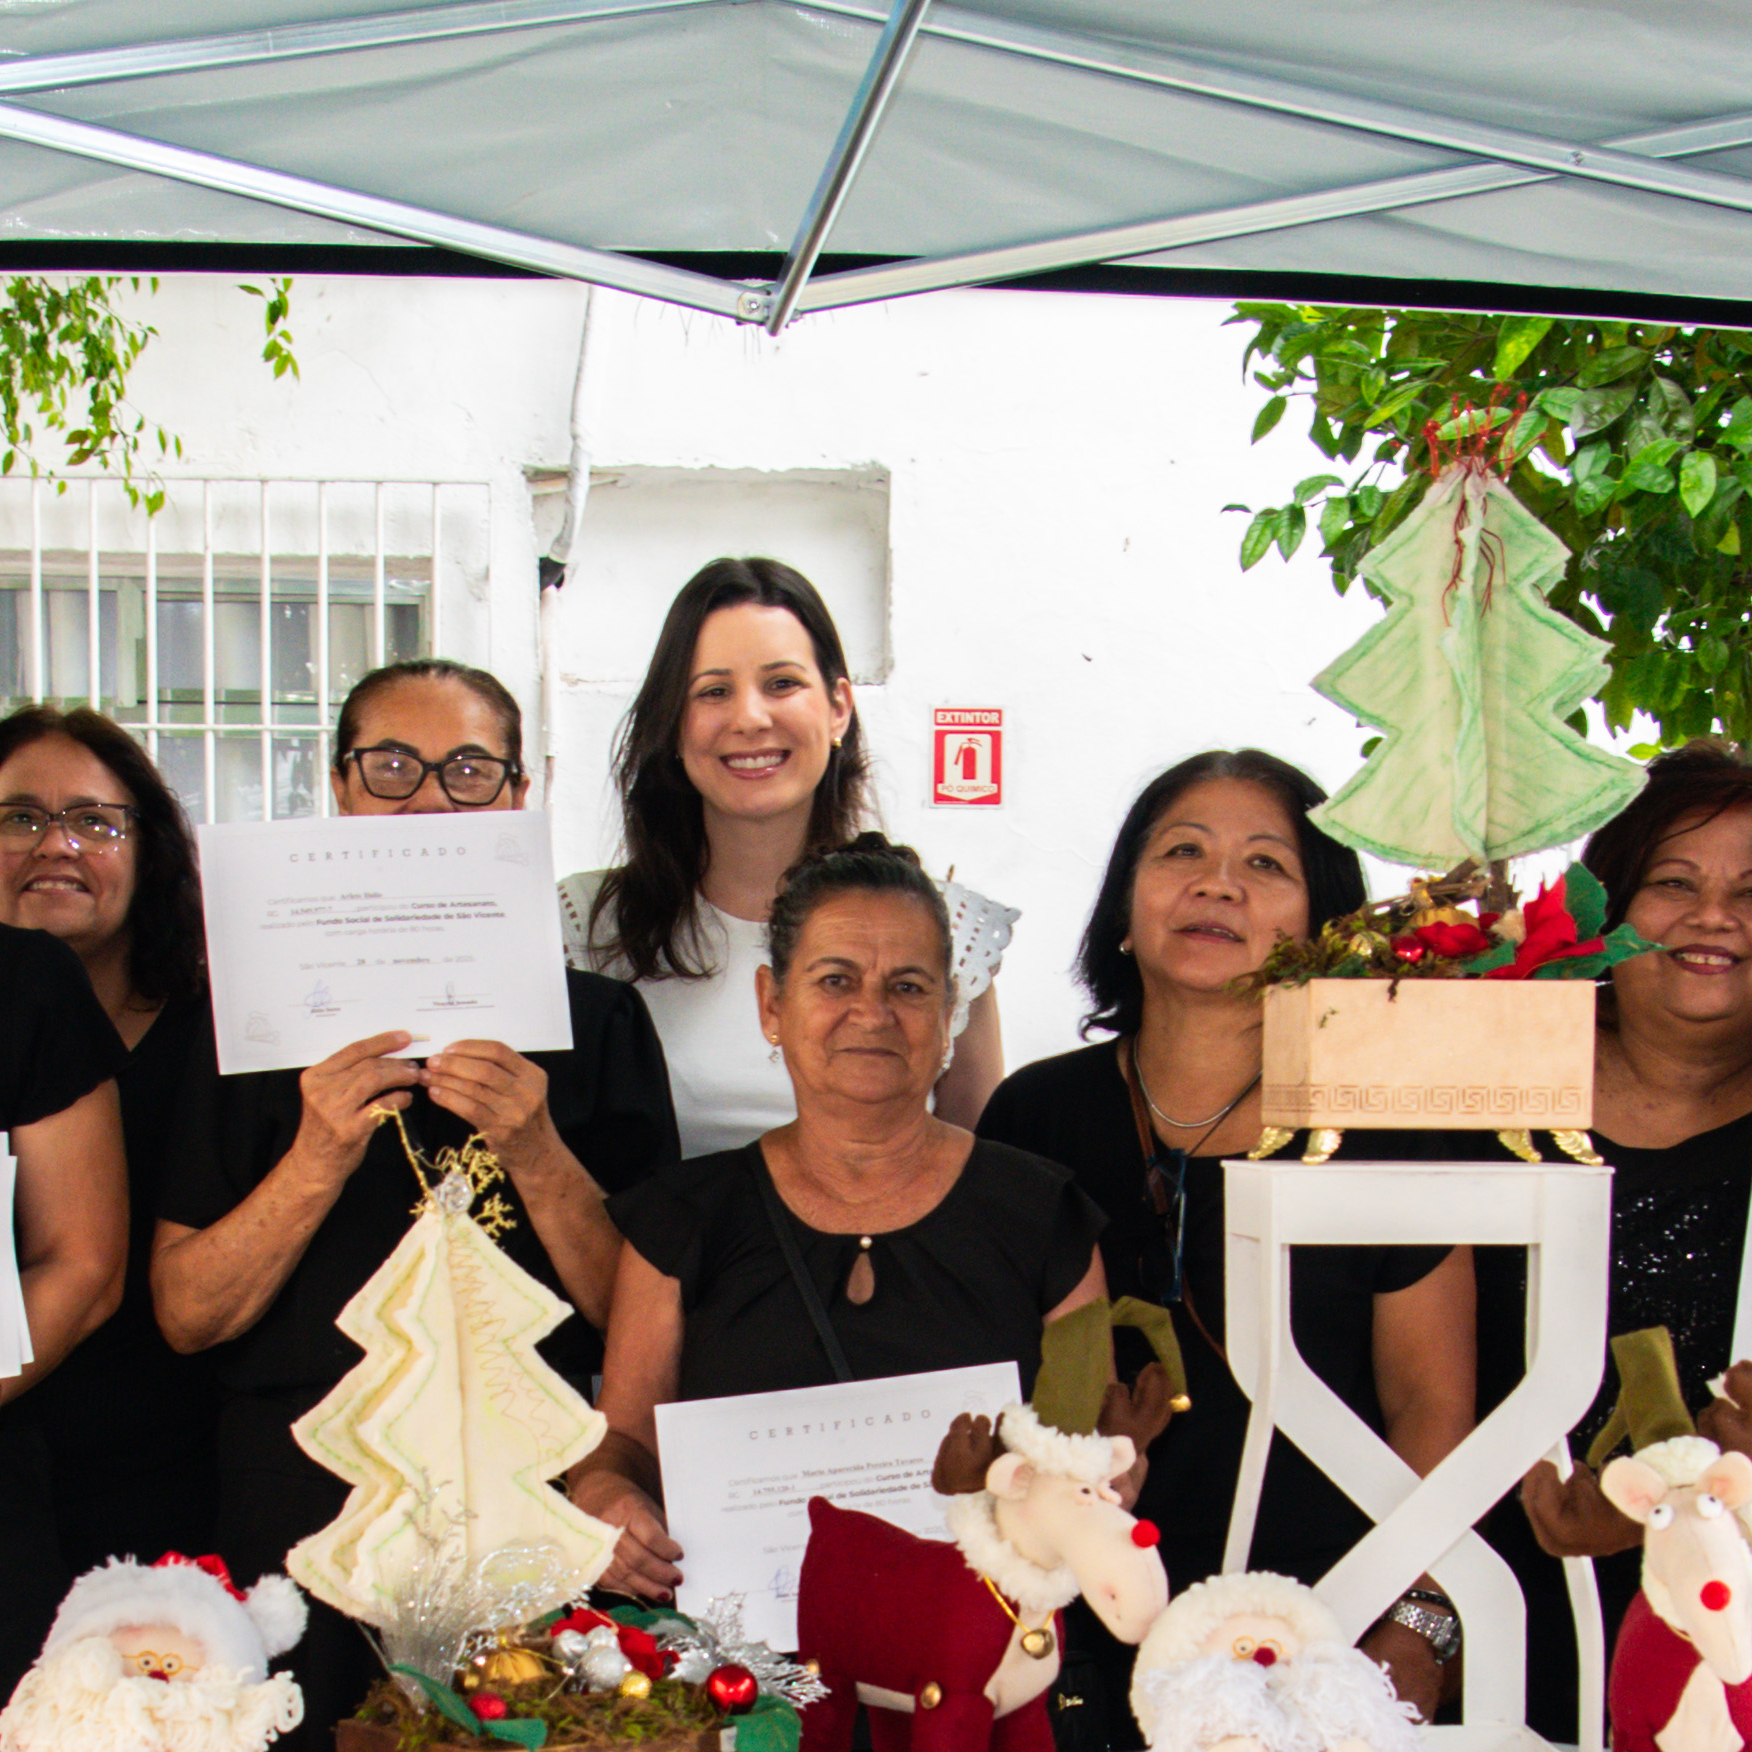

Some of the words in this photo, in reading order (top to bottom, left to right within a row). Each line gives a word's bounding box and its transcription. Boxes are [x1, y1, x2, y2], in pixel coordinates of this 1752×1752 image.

[937, 711, 1000, 724] EXTINTOR
[289, 847, 466, 863] CERTIFICADO
[749, 1409, 931, 1440] CERTIFICADO
[778, 1496, 806, 1506] Fundo
[835, 1491, 846, 1500] de
[848, 1483, 908, 1498] Solidariedade
[909, 1482, 921, 1490] de
